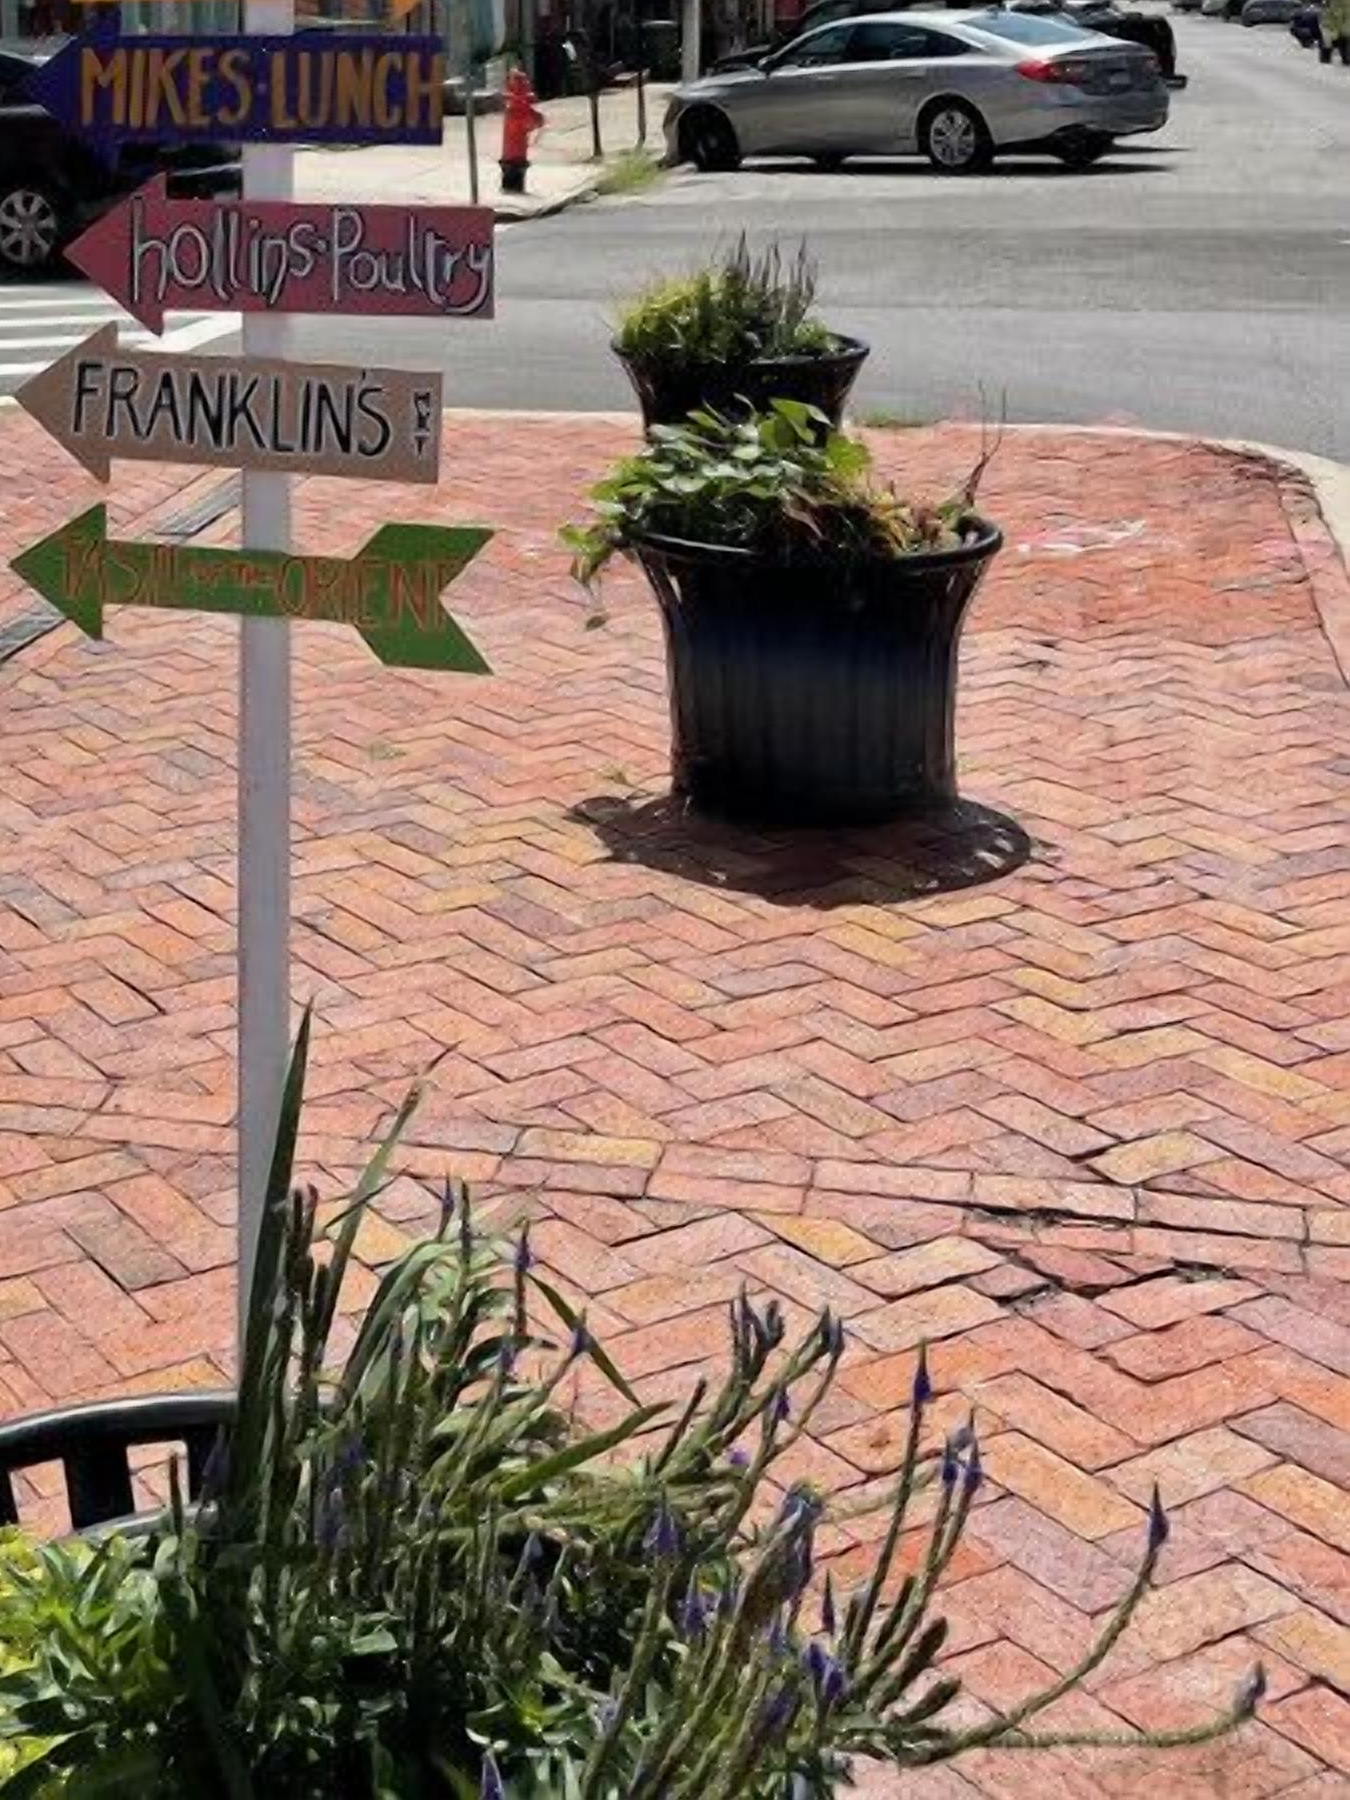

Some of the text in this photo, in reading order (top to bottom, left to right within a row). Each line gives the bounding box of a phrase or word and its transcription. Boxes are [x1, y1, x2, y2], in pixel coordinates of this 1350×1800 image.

[81, 47, 443, 130] MIKES LUNCH
[331, 207, 492, 315] Poultry
[73, 361, 392, 457] FRANKLIN'S
